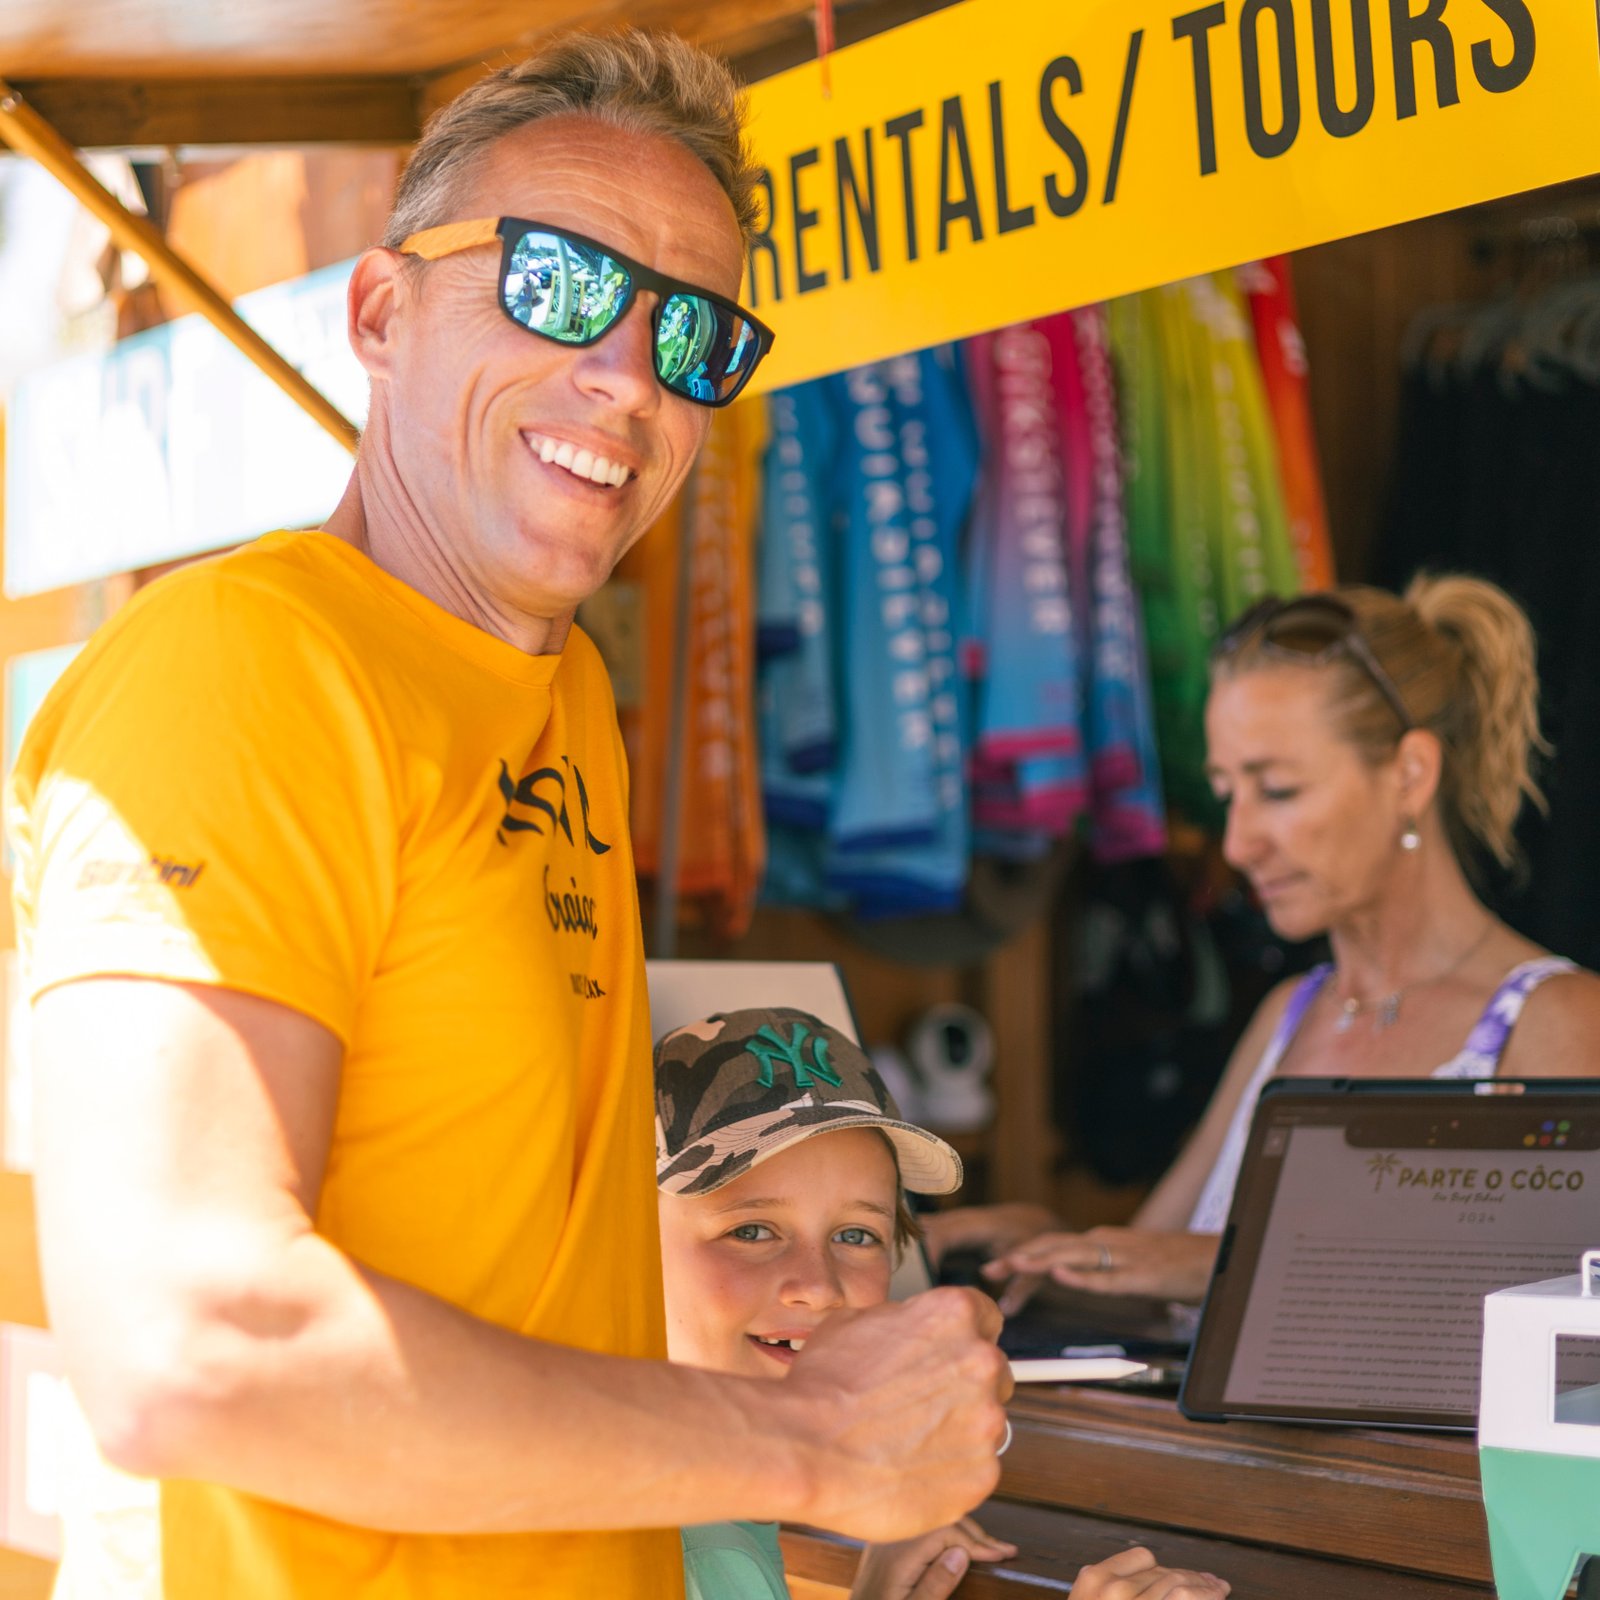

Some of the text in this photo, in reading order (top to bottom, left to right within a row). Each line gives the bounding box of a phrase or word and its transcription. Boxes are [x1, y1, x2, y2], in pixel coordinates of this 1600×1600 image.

[745, 1022, 843, 1089] NY
[1397, 1164, 1585, 1192] PARTE O CÔCO
